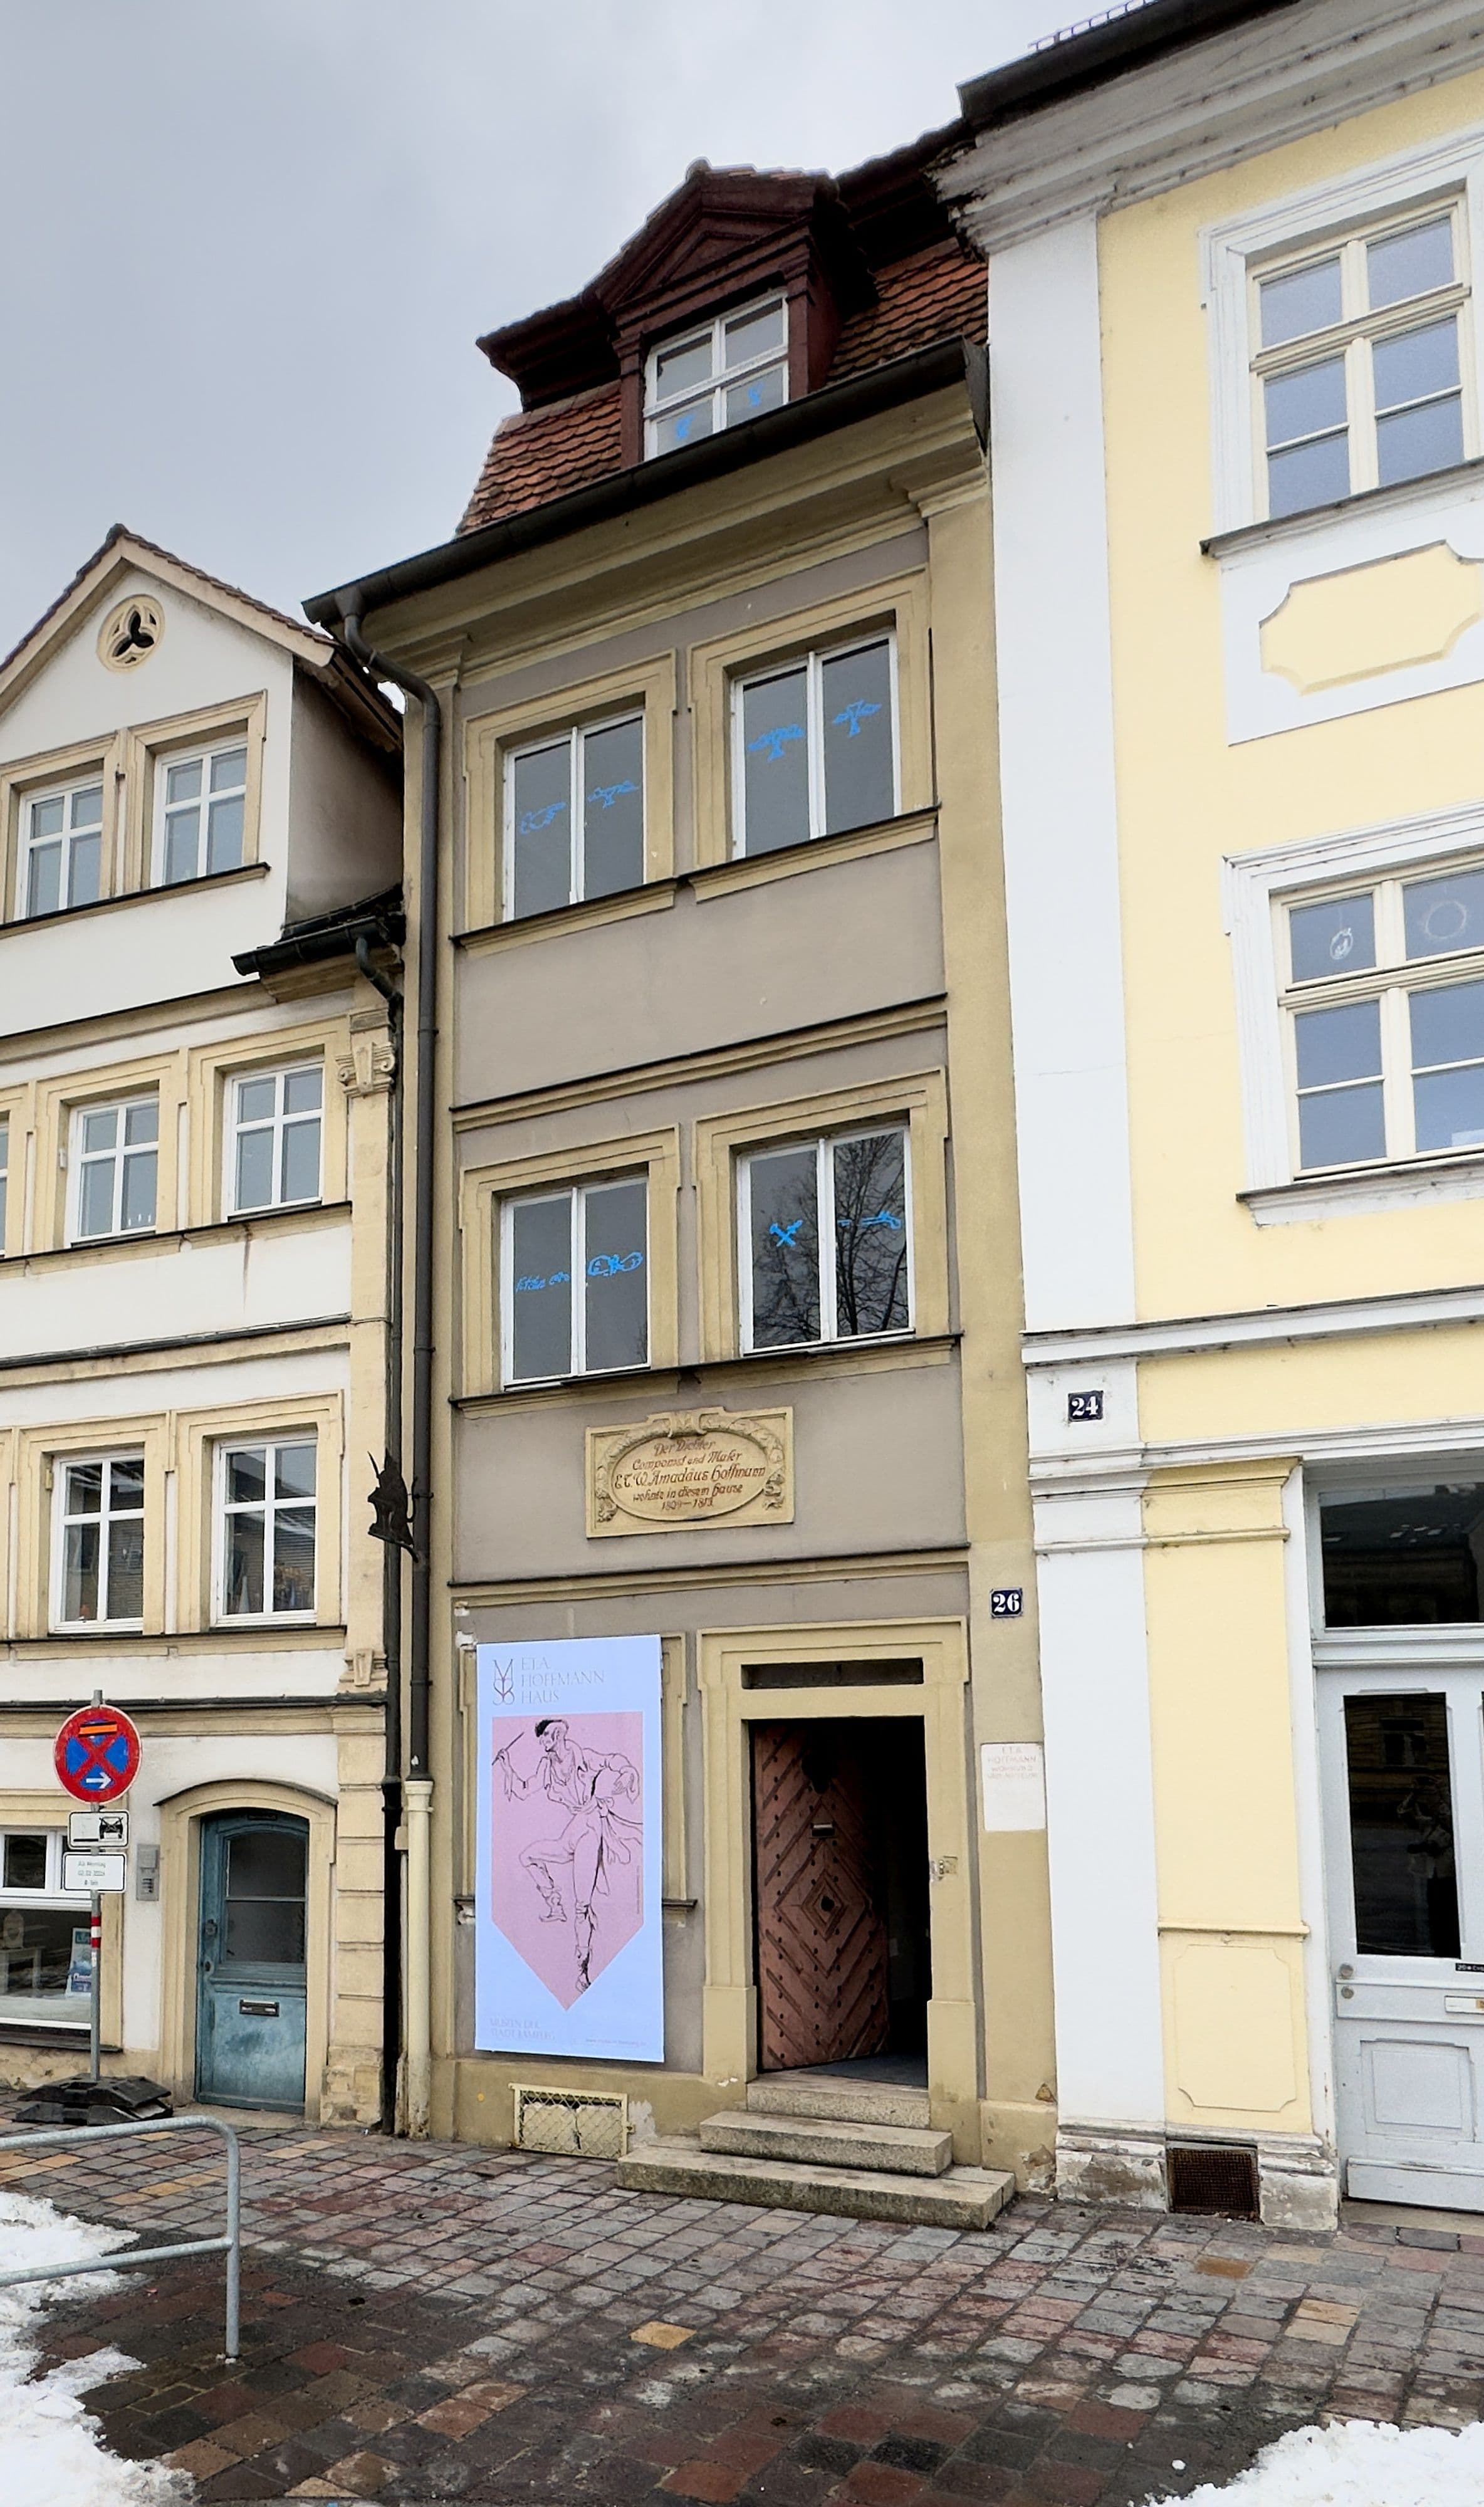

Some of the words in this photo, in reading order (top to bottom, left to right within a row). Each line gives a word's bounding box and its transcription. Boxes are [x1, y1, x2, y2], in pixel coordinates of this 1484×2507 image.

[1071, 1396, 1099, 1416] 24
[993, 1593, 1020, 1613] 26
[521, 1670, 605, 1687] HOFFMANN
[521, 1690, 560, 1705] HAUS
